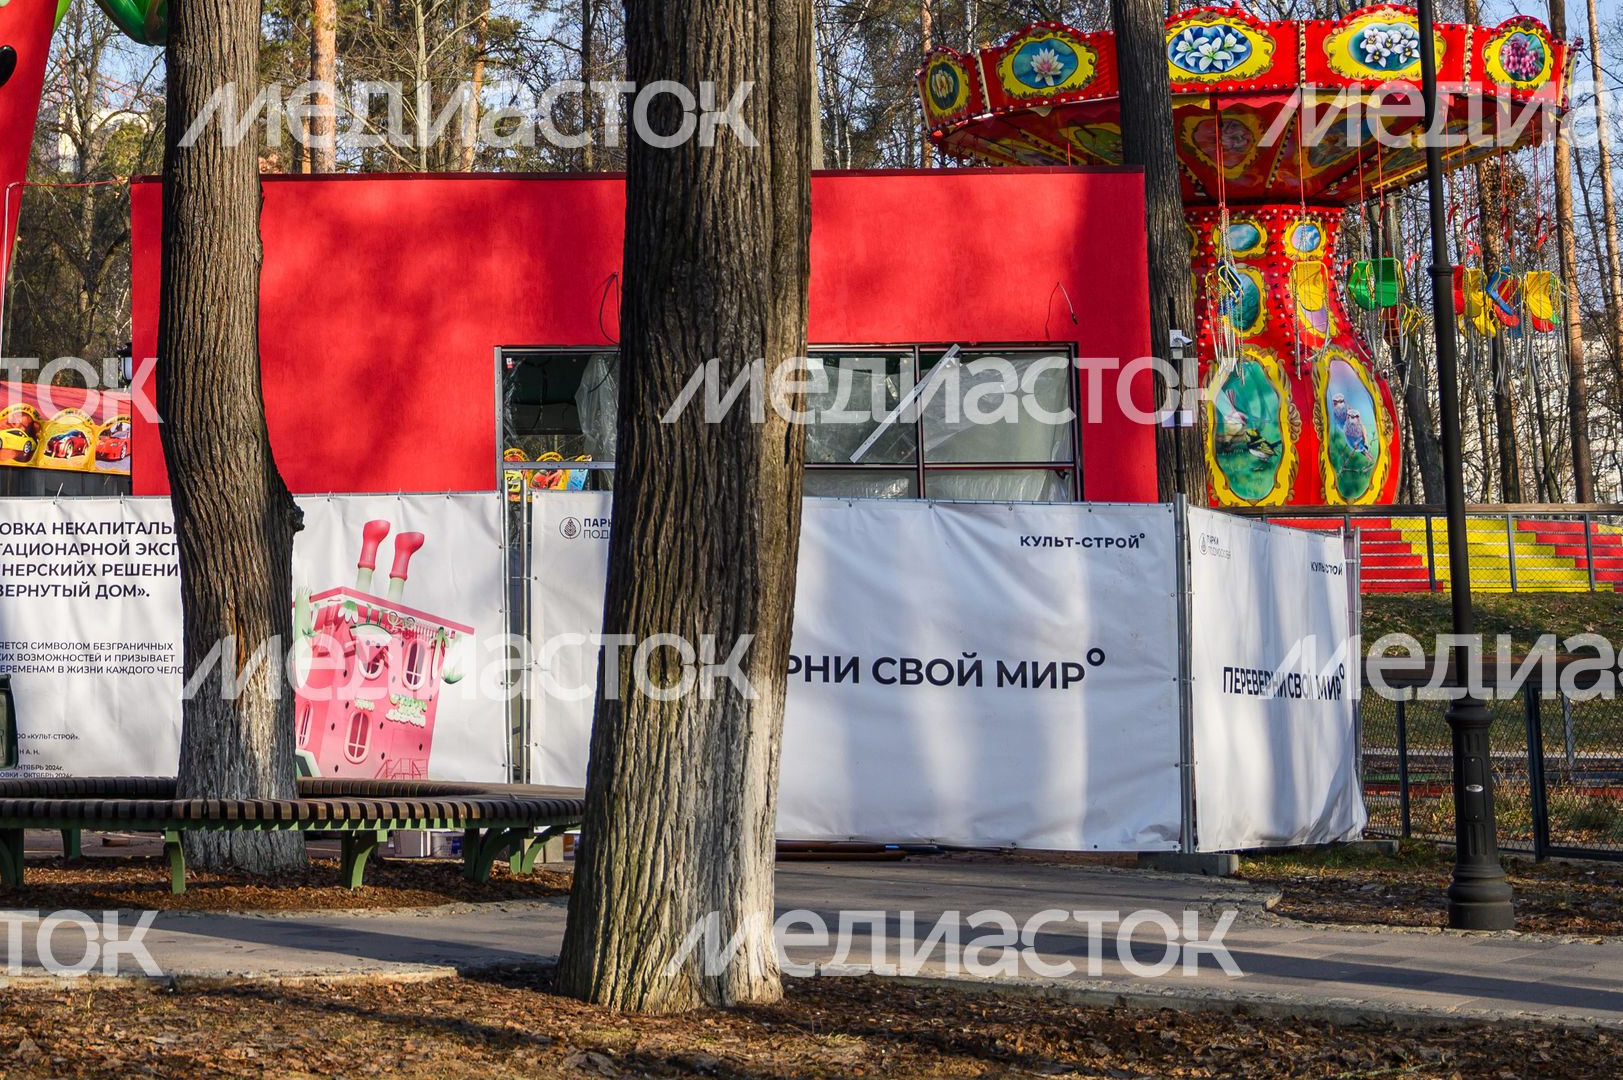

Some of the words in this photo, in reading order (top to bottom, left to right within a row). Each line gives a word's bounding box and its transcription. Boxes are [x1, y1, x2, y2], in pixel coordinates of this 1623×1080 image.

[52, 521, 177, 536] НЕКАПИТАЛЬ
[95, 584, 150, 600] ДОМ».
[30, 642, 90, 651] СИМВОЛОМ
[93, 642, 173, 651] БЕЗГРАНИЧНЫХ
[17, 652, 102, 662] ВОЗМОЖНОСТЕЙ
[104, 654, 112, 662] И
[115, 654, 175, 663] ПРИЗЫВАЕТ
[57, 665, 64, 674] В
[67, 665, 103, 674] ЖИЗНИ
[106, 665, 154, 675] КАЖДОГО
[871, 652, 983, 687] СВОЙ
[1223, 666, 1287, 698] ПЕРЕВЕРНИ
